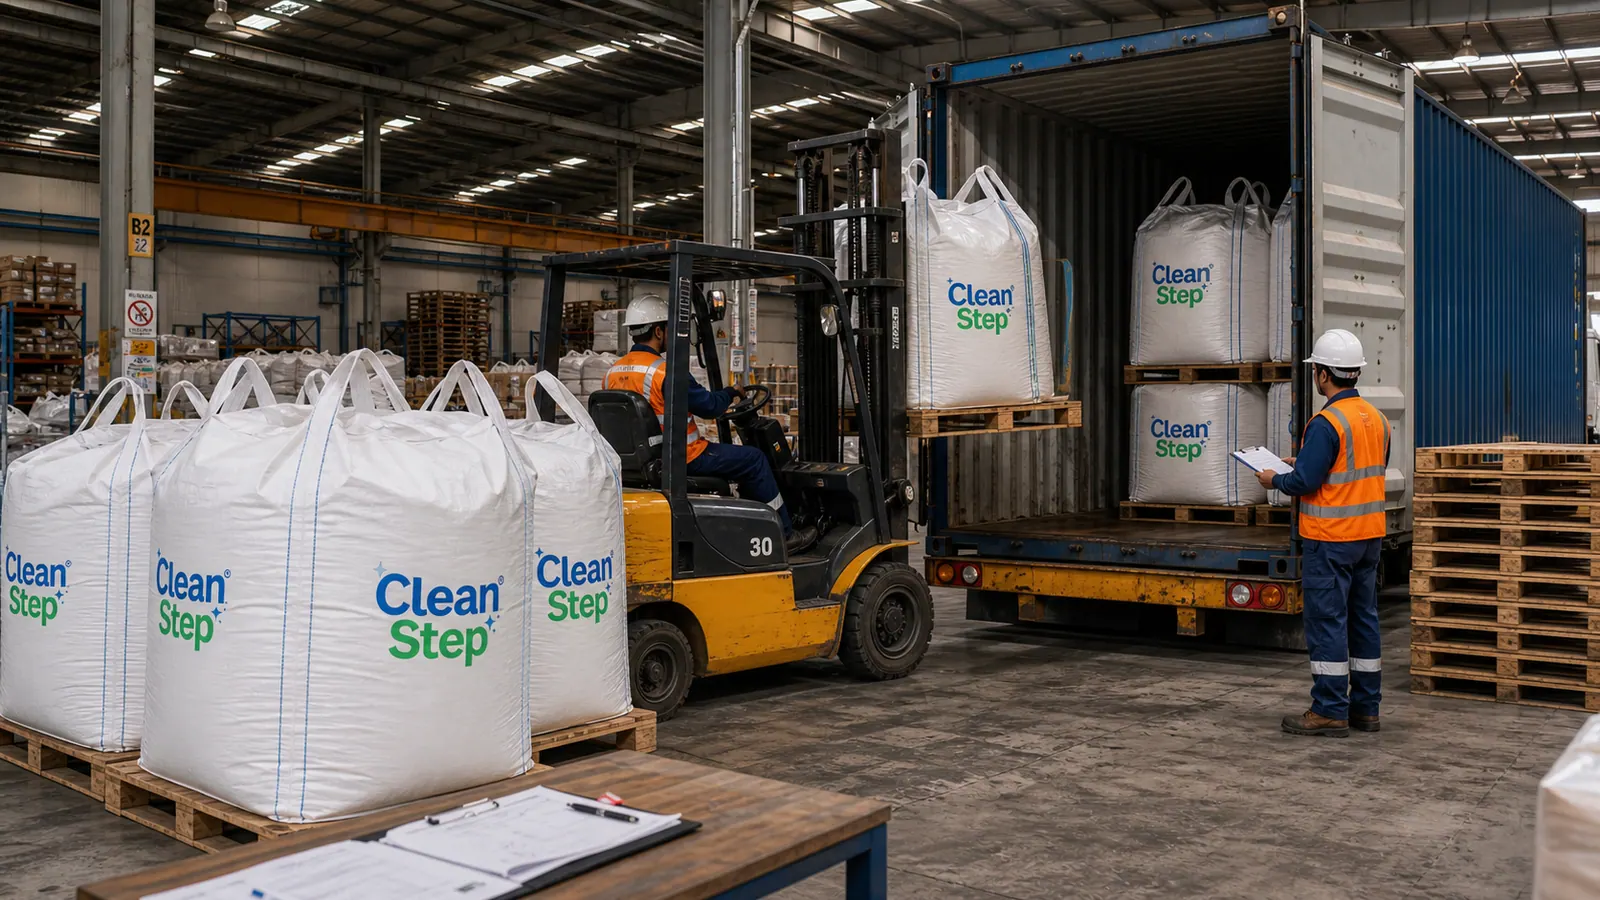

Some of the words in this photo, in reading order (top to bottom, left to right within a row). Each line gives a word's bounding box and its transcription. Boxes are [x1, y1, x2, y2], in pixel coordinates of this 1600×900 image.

[132, 217, 150, 236] B2
[1156, 285, 1203, 308] Step
[957, 307, 1008, 335] Step
[1156, 439, 1201, 462] Step
[750, 536, 773, 557] 30
[9, 585, 58, 627] Step
[548, 590, 609, 624] Step
[159, 599, 214, 651] Step
[388, 619, 489, 667] Step
